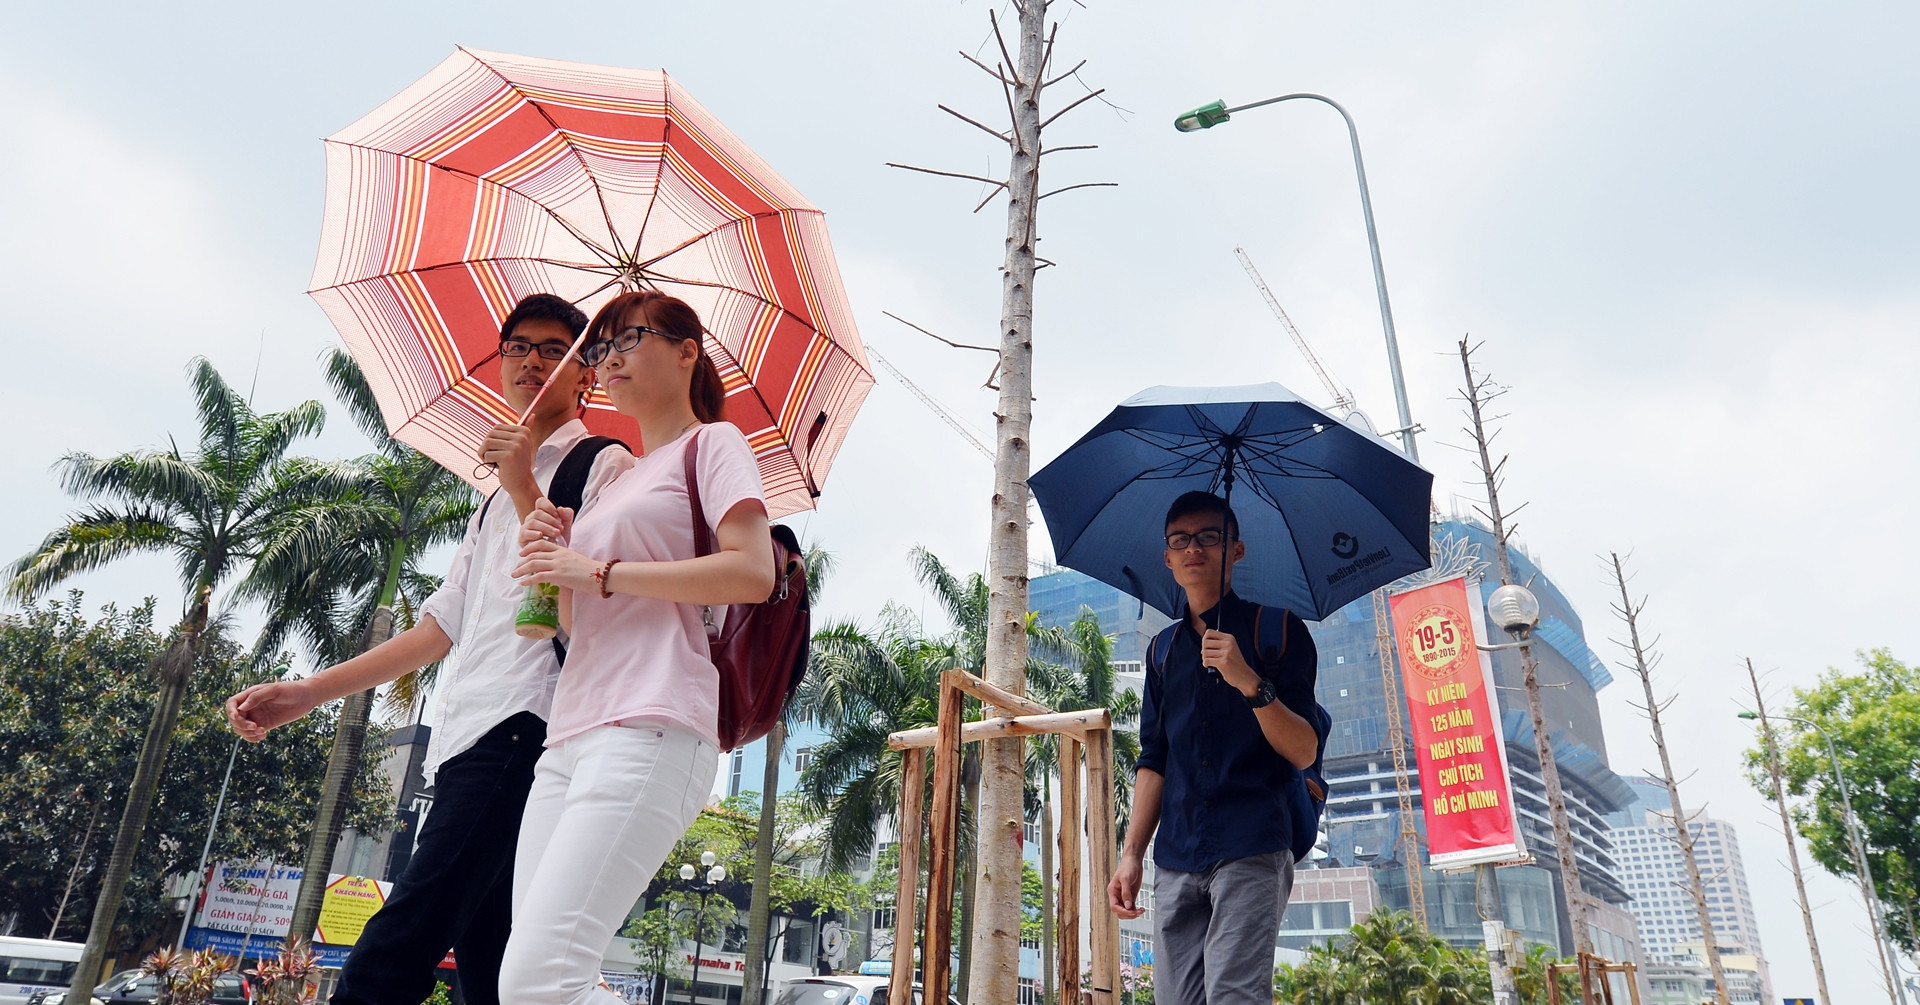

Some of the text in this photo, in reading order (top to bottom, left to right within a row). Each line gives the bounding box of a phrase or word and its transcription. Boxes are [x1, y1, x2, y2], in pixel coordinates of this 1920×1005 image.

[1415, 620, 1455, 652] 19-5
[1422, 647, 1456, 663] 1890-2015
[1426, 680, 1468, 707] KỶ NIỆM
[1430, 706, 1475, 733] 125 NĂM
[1429, 735, 1485, 761] NGÀY SINH
[1438, 760, 1485, 787] CHỦ TỊCH
[1433, 789, 1499, 816] HỒ CHÍ MINH
[272, 889, 289, 900] GIÁ
[255, 914, 267, 924] 20
[687, 954, 731, 970] Ymaha
